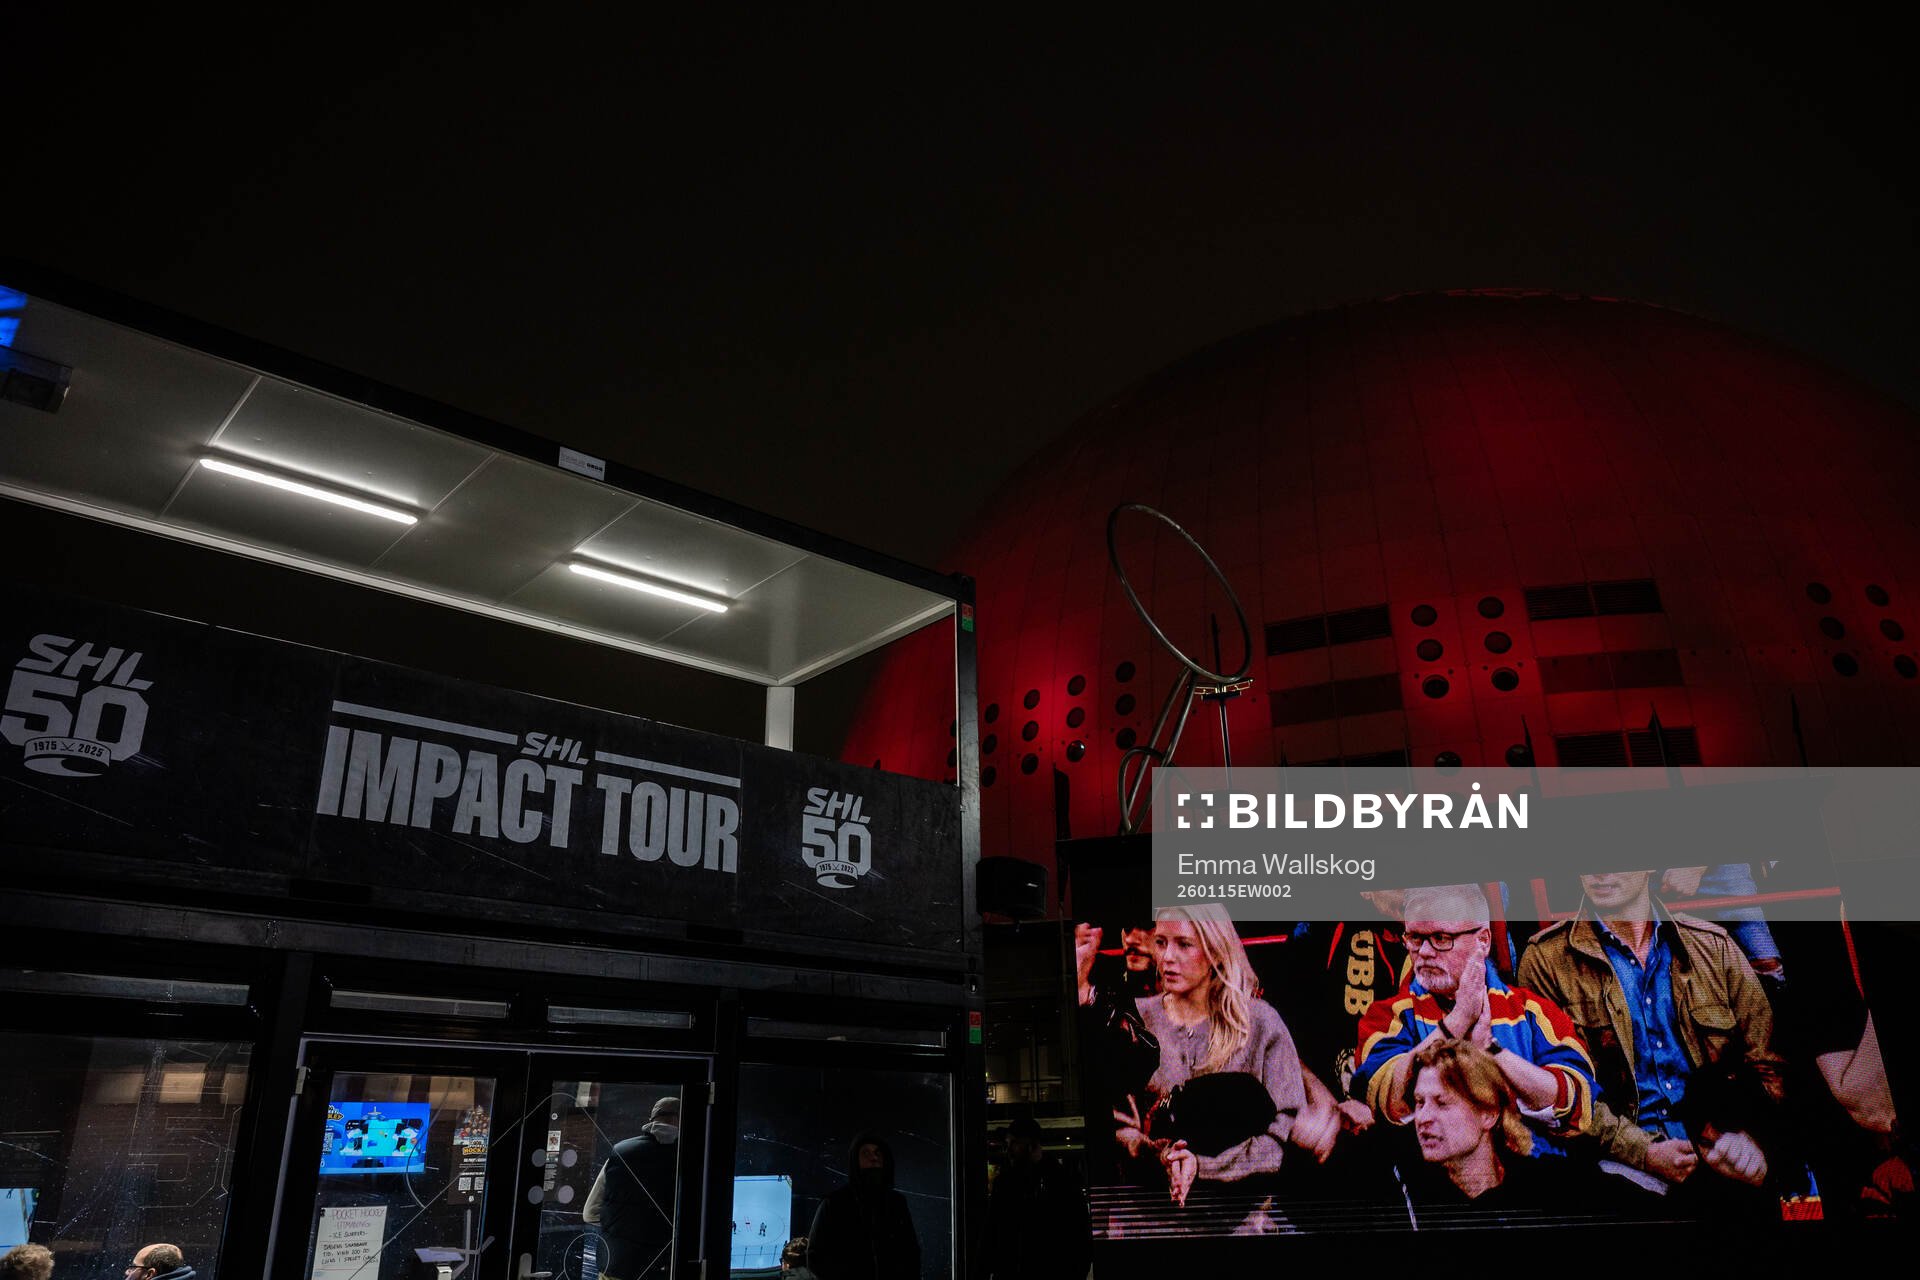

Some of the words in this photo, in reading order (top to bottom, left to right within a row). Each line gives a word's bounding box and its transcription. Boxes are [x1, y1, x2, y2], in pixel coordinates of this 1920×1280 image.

[16, 632, 156, 691] SHL
[0, 669, 150, 762] 50
[33, 740, 57, 752] 1975
[77, 743, 105, 758] 2025
[520, 731, 590, 765] SHL
[315, 724, 584, 849] IMPACT
[596, 773, 742, 874] TOUR
[803, 786, 871, 824] SHL
[802, 814, 872, 877] 50
[819, 863, 832, 872] 1975
[840, 863, 854, 874] 2025
